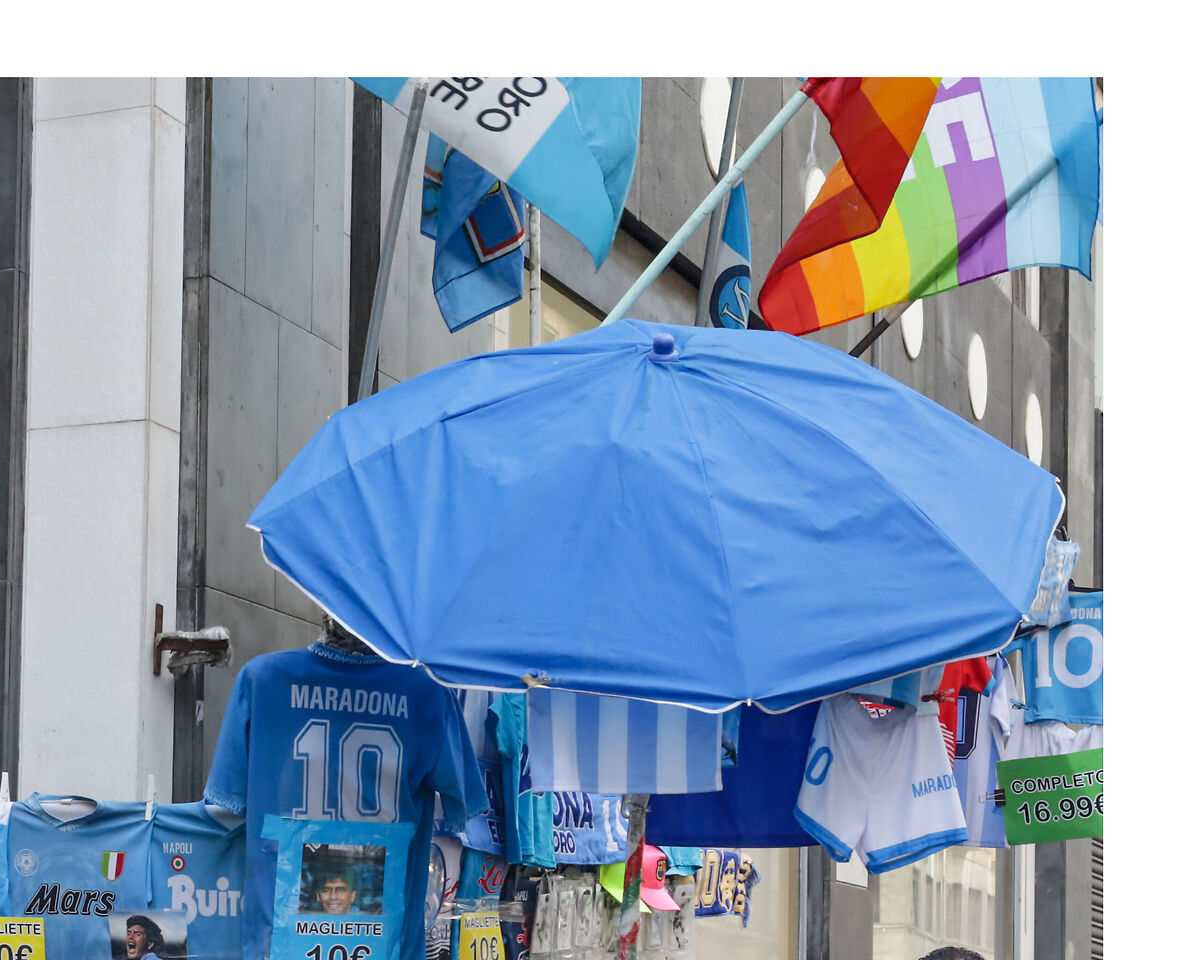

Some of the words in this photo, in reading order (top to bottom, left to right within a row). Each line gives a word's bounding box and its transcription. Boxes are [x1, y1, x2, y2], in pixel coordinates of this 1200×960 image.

[291, 684, 410, 719] MARADONA
[293, 718, 404, 823] 10
[162, 842, 193, 855] NAPOLI
[24, 883, 115, 918] Mars
[163, 873, 245, 926] Buit
[296, 920, 383, 937] MAGLIETTE
[464, 915, 501, 930] MAGLIETTE
